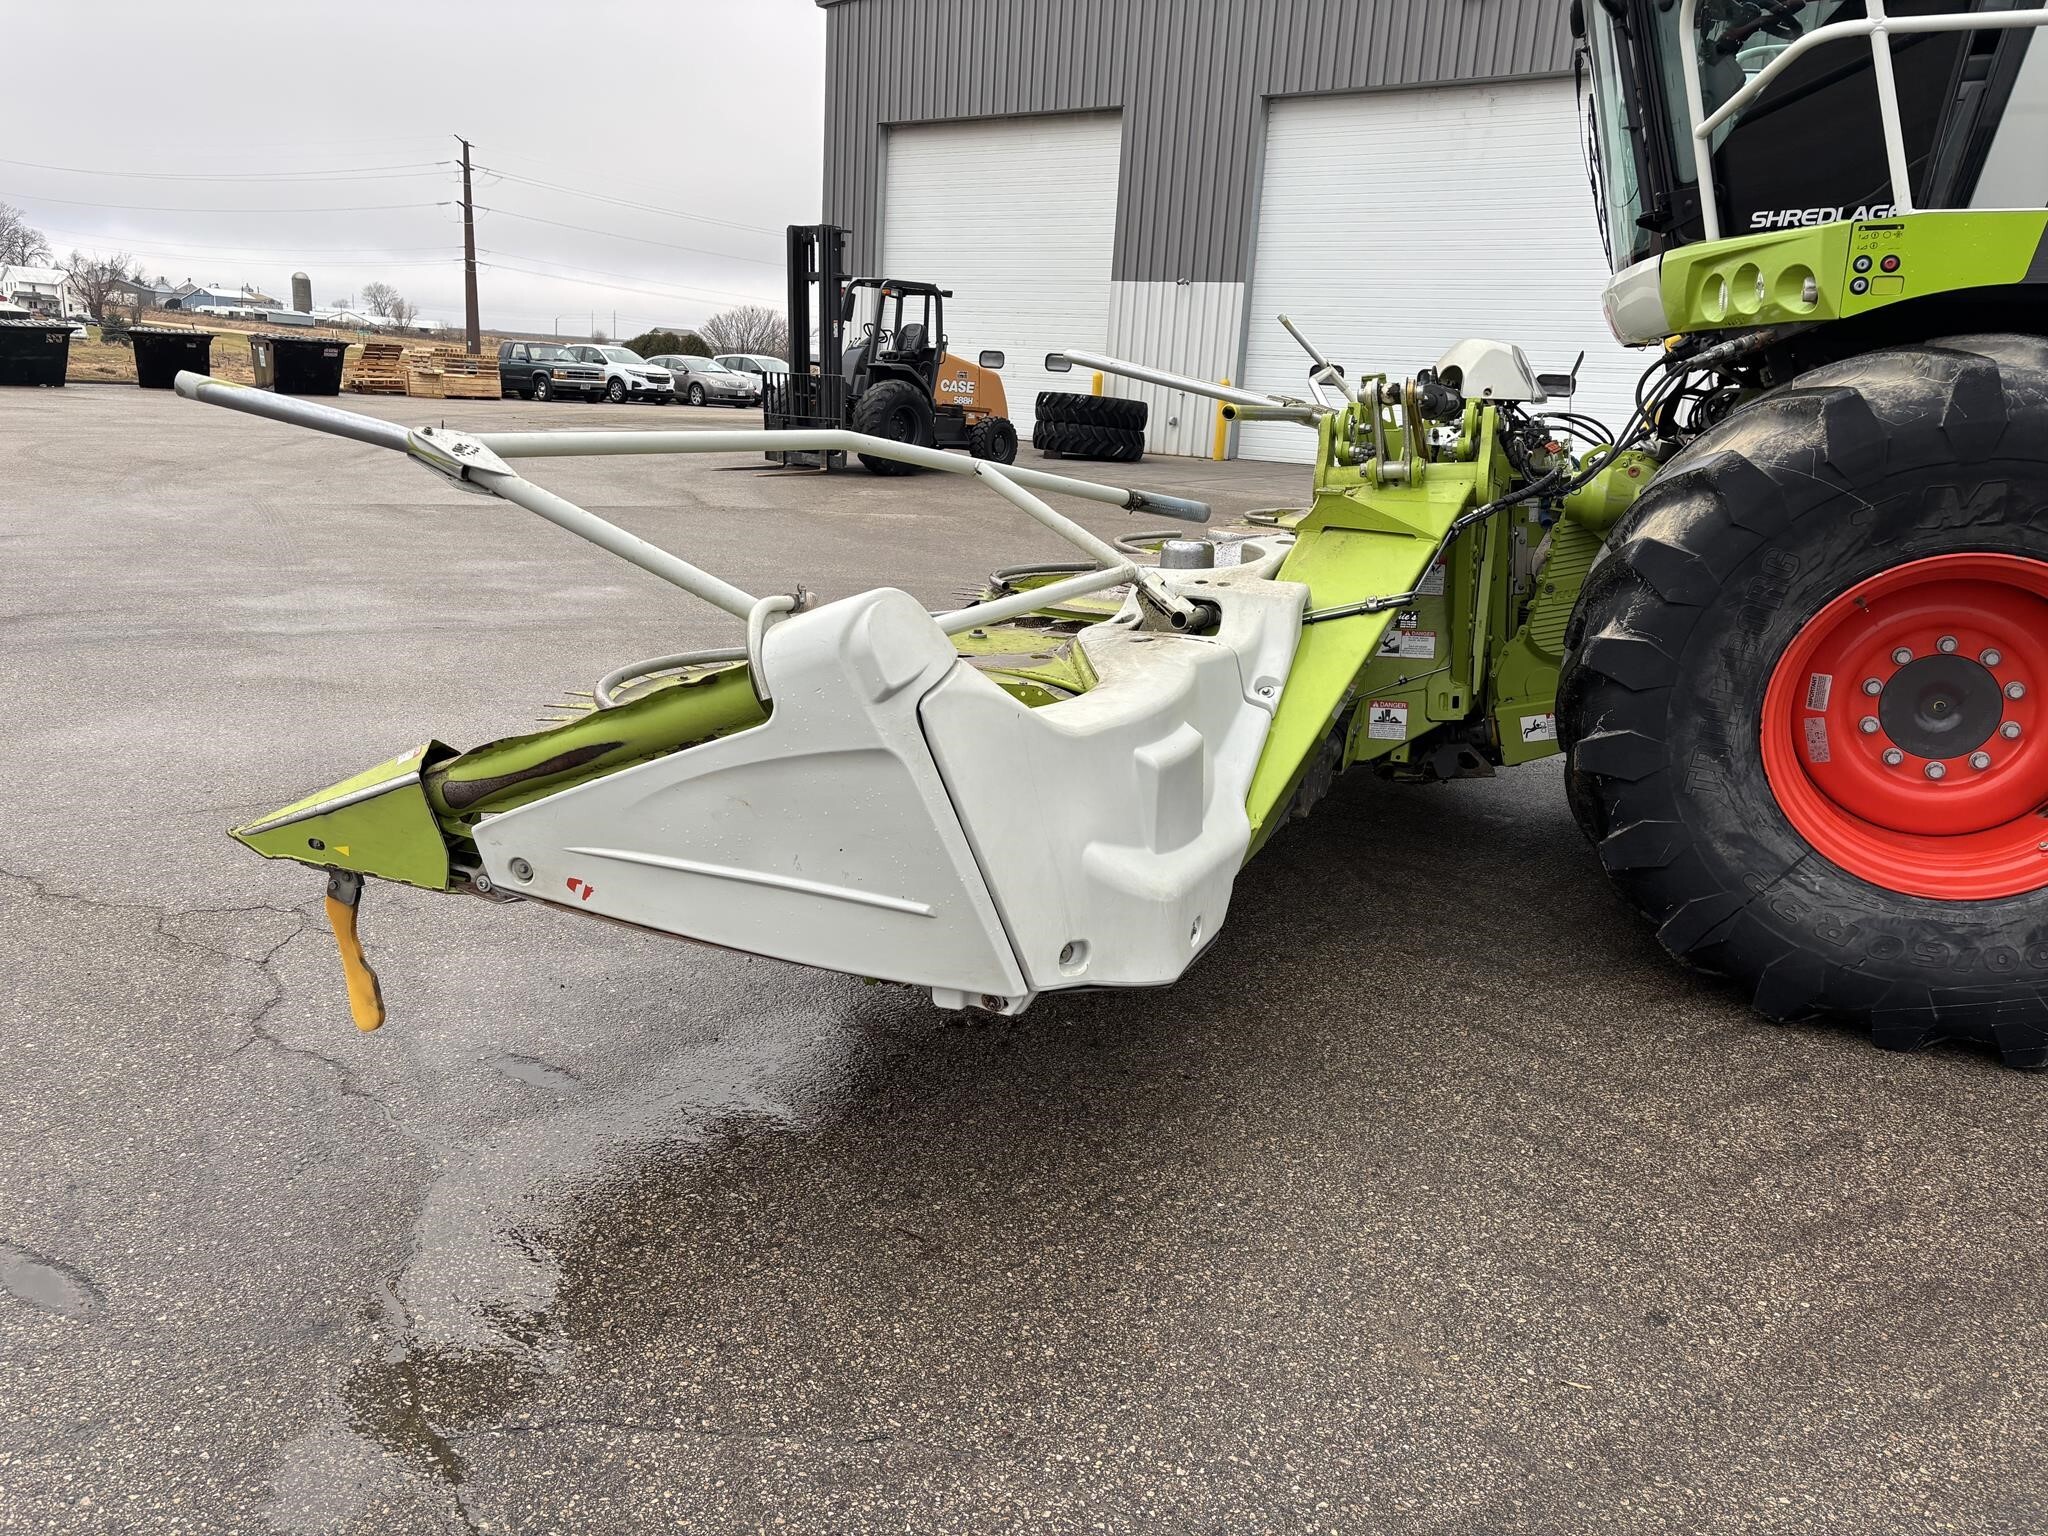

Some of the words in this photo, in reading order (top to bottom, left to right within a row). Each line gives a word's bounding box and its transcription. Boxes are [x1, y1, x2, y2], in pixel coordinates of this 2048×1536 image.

[940, 379, 976, 394] CASE
[953, 396, 974, 405] 588H
[1807, 675, 1818, 707] IMPORTANT
[1380, 701, 1407, 709] DANGER
